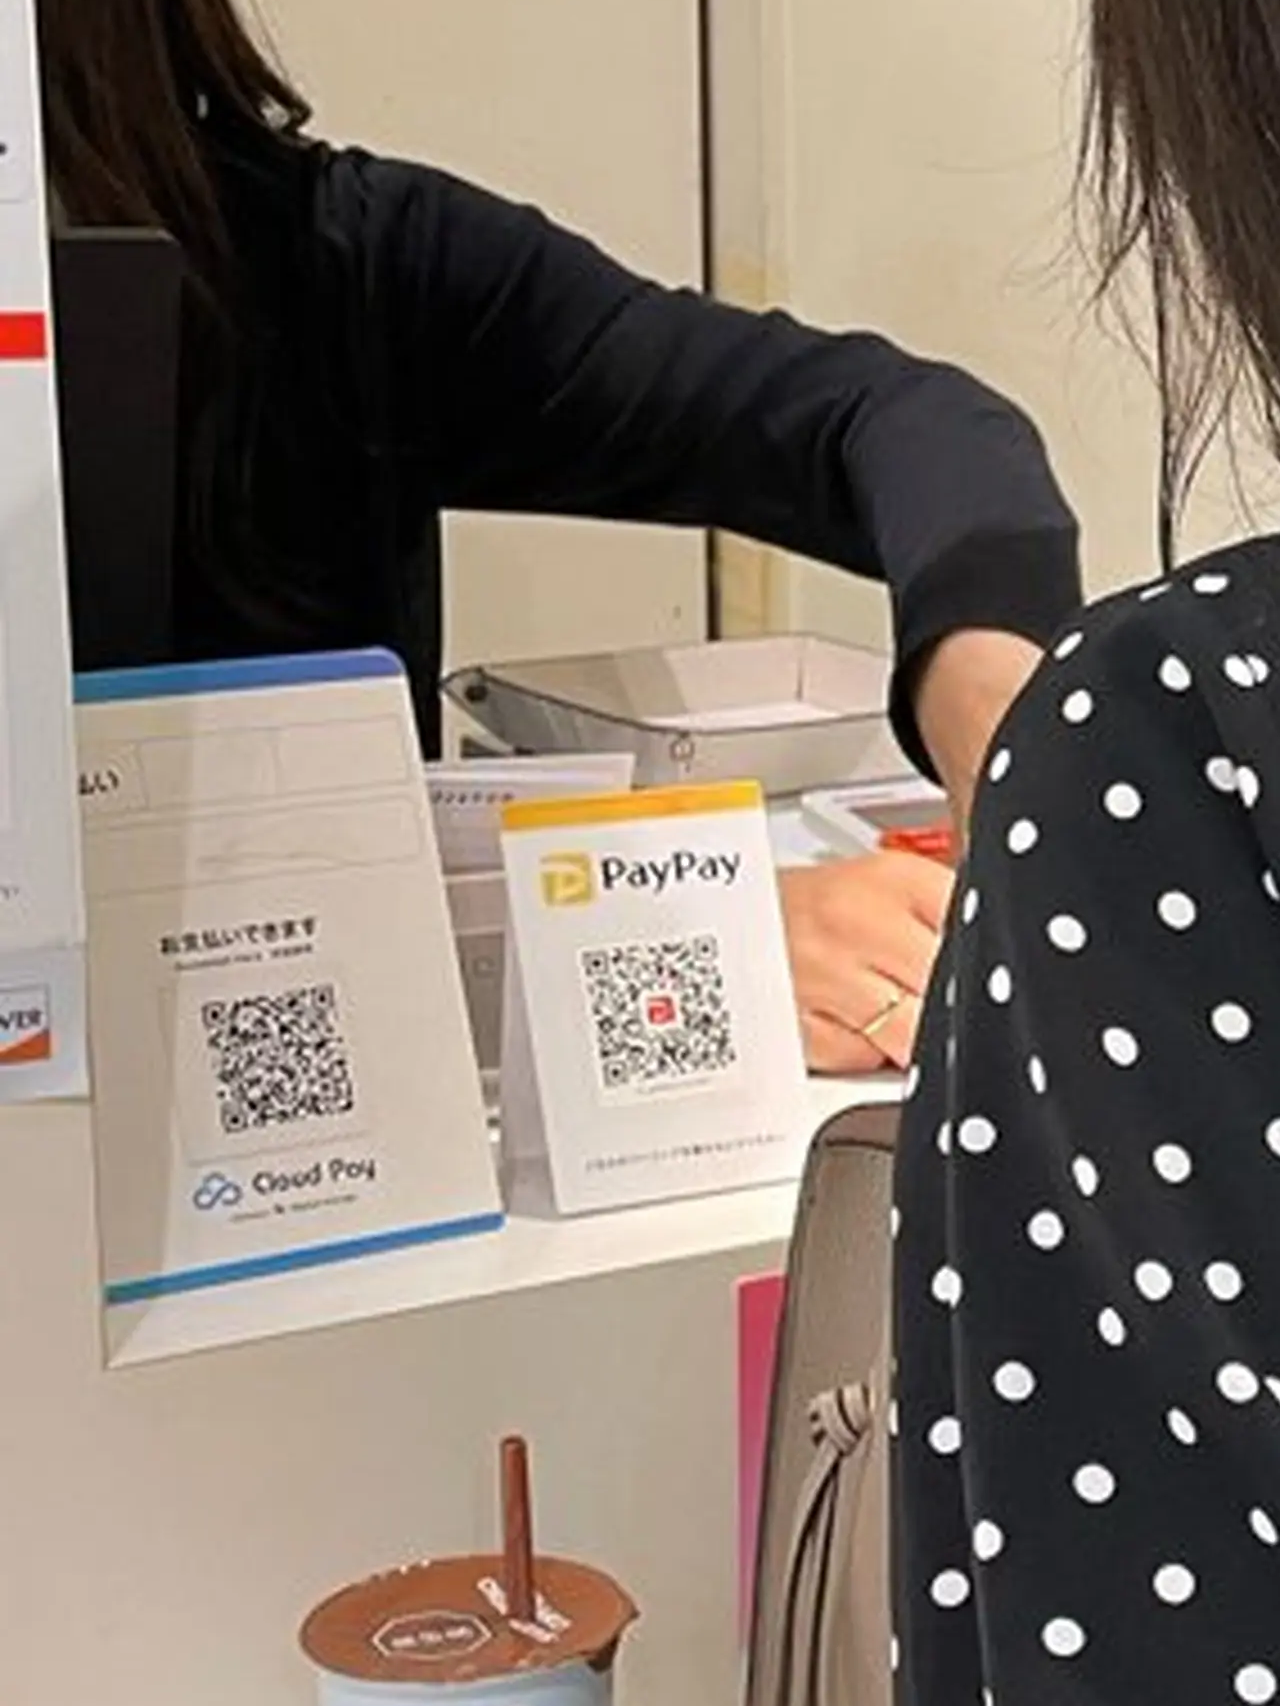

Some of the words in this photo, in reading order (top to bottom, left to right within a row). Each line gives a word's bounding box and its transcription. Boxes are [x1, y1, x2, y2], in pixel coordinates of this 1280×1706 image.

[600, 849, 742, 895] PayPay
[252, 1161, 323, 1195] Cloud
[328, 1157, 377, 1183] Pay
